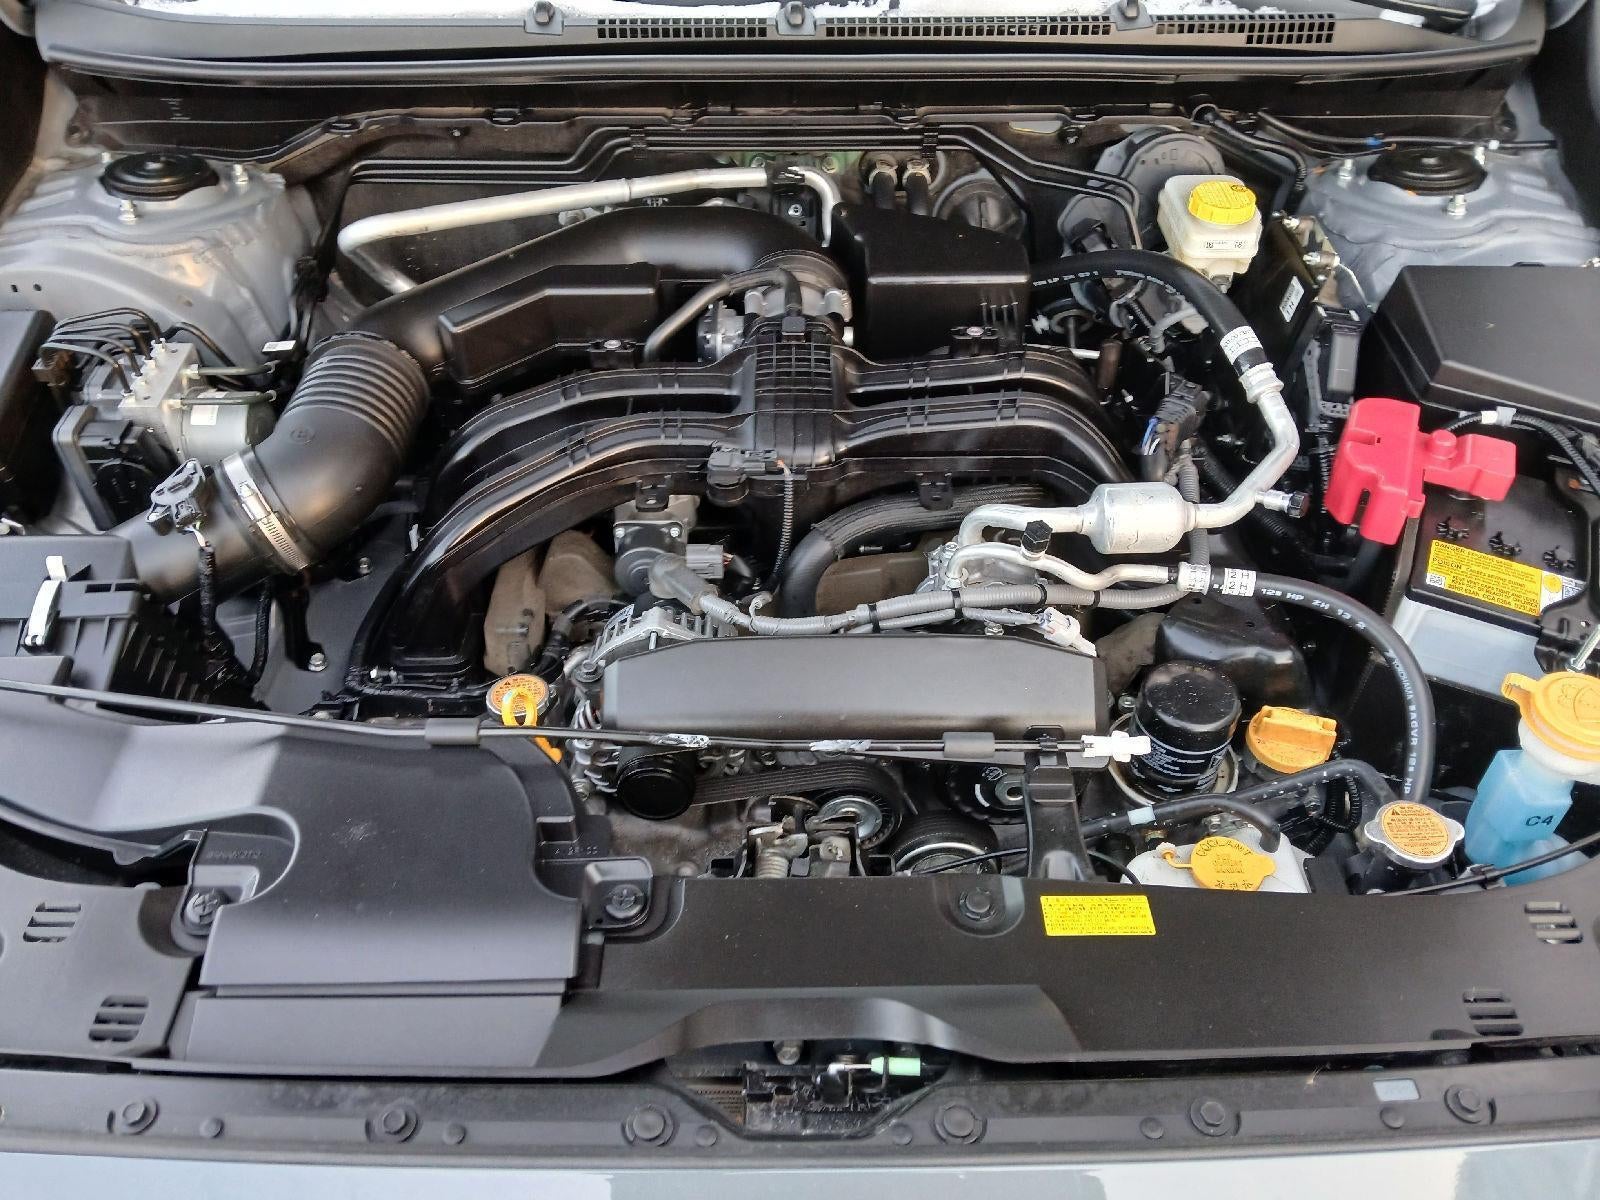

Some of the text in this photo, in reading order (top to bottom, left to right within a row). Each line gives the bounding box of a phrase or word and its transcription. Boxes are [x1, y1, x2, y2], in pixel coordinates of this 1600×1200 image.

[1434, 541, 1466, 554] DANGER
[1432, 556, 1463, 570] POISON
[1495, 586, 1511, 596] TIGHT
[1512, 596, 1540, 609] CHILDREN
[1525, 815, 1554, 826] C4
[1195, 839, 1253, 857] COOLANT
